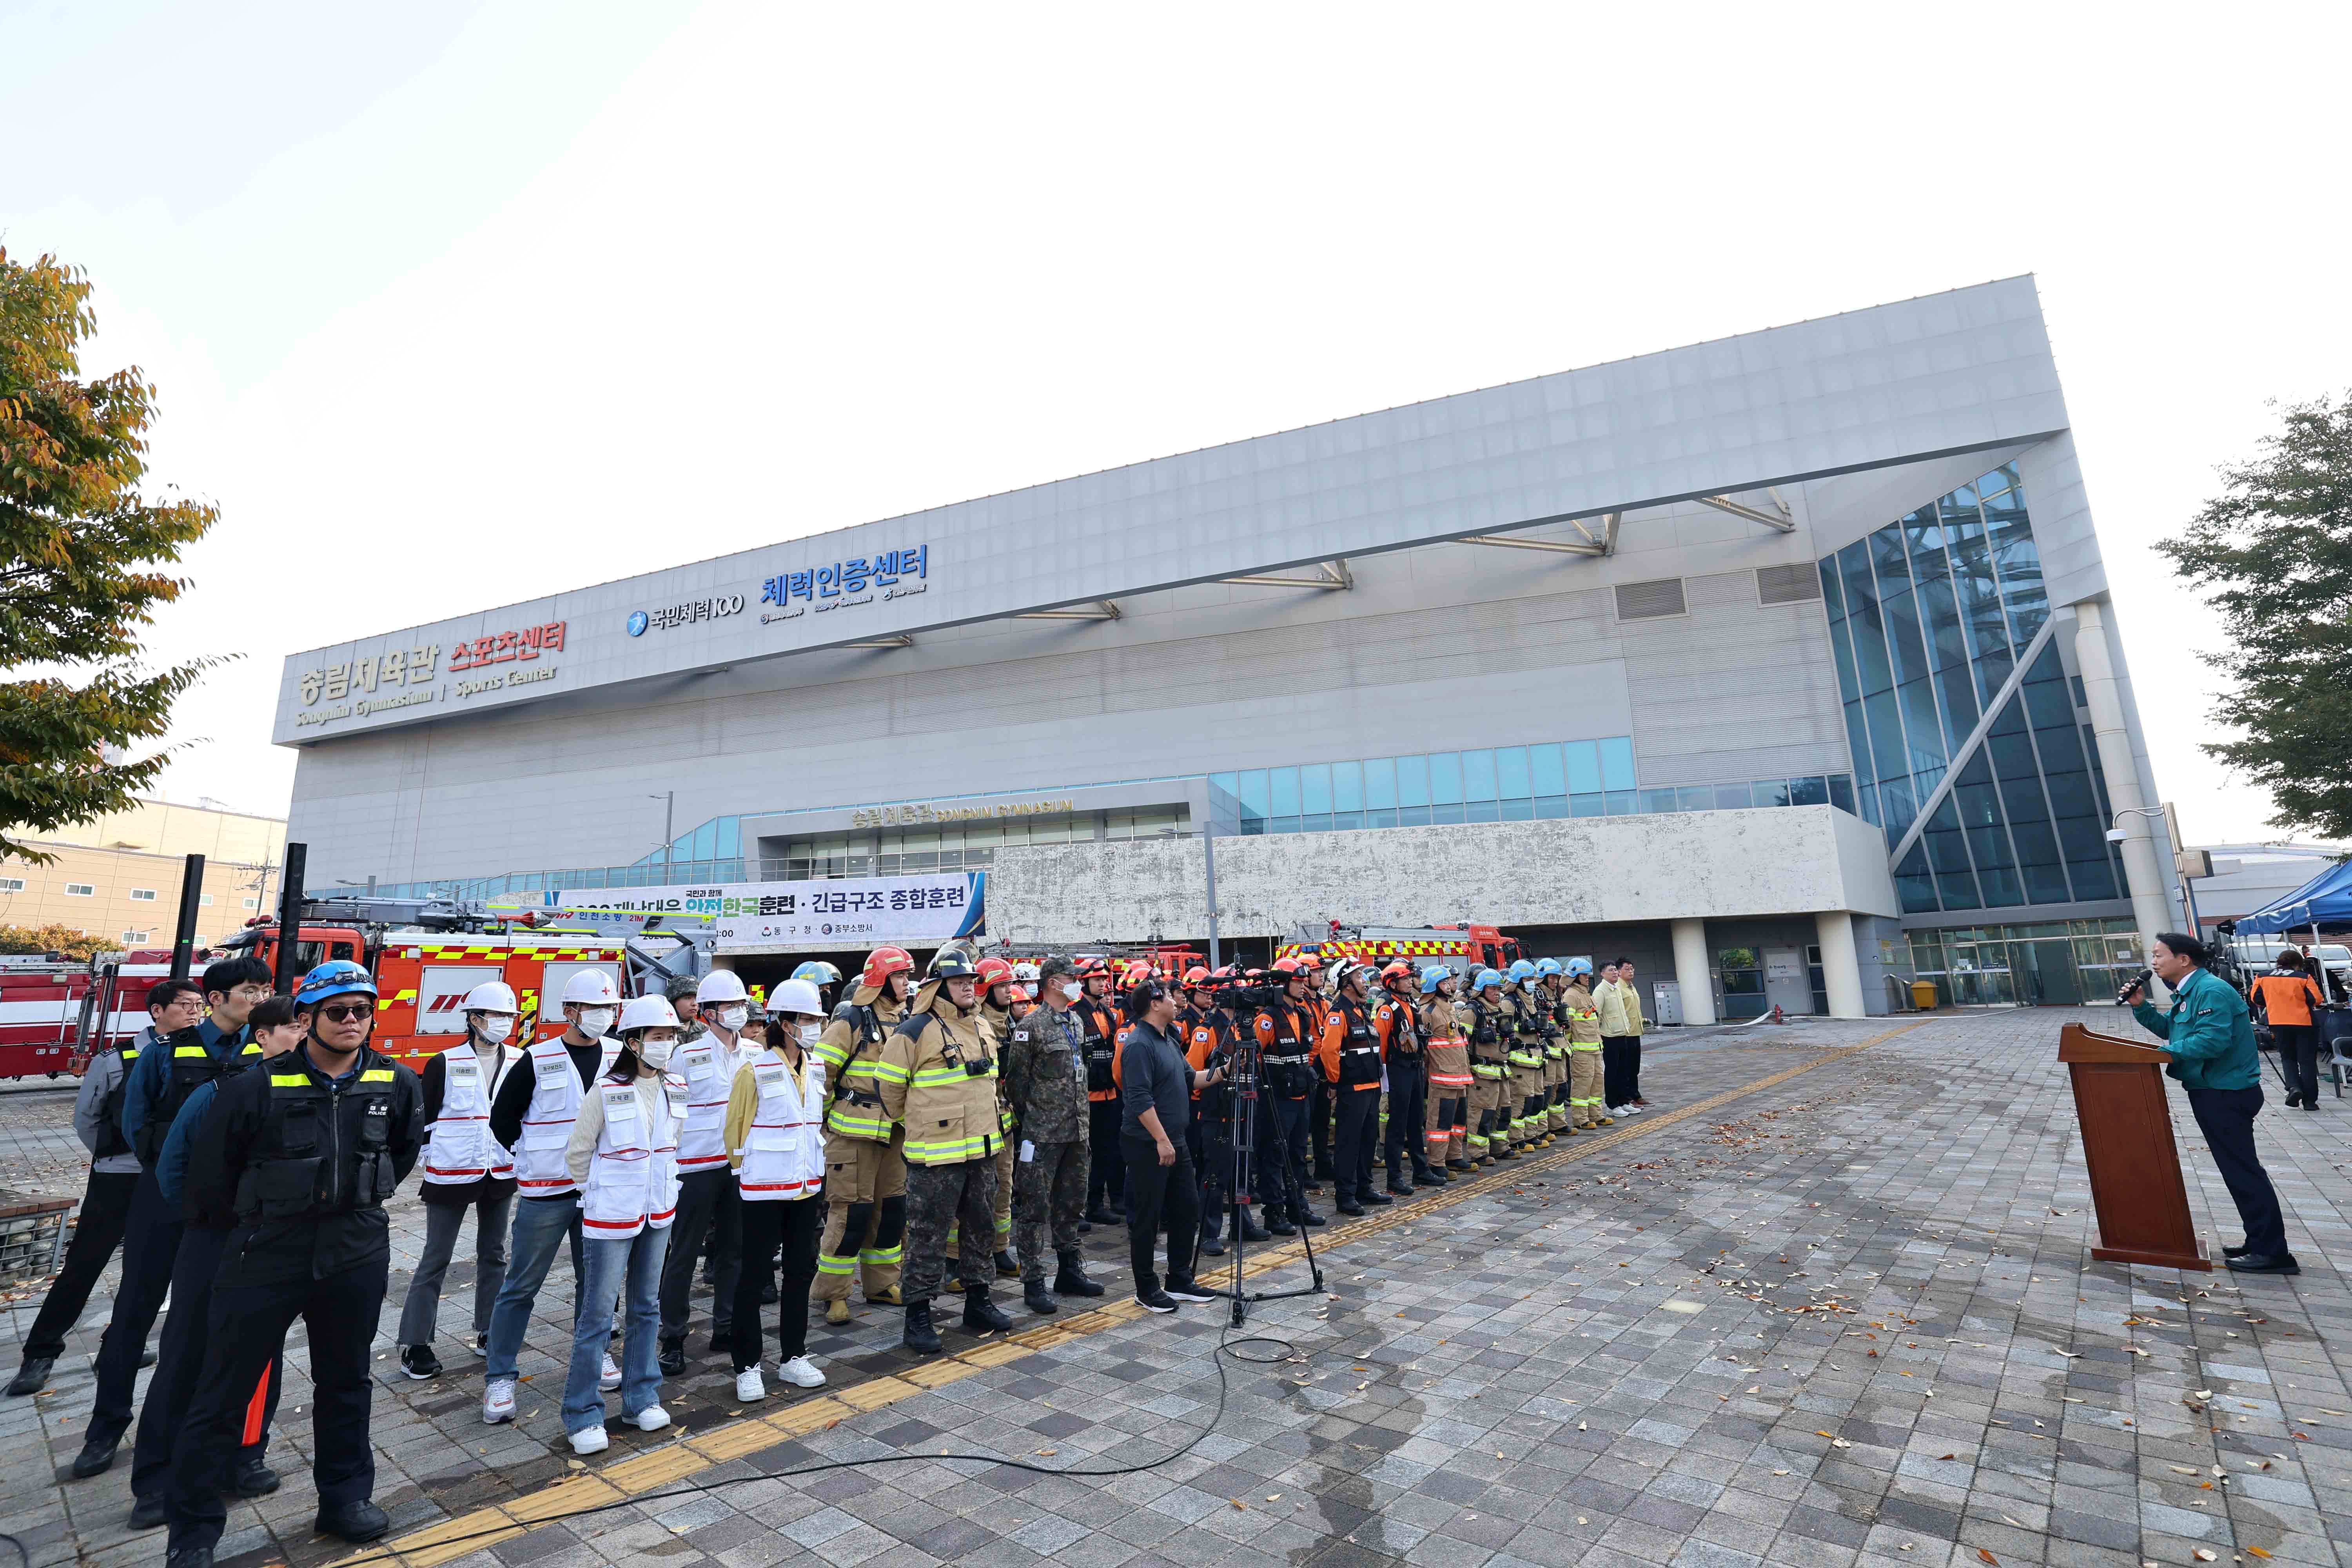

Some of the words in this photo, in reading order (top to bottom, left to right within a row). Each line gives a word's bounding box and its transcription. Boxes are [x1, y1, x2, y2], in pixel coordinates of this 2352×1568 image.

[760, 543, 927, 606] 체력인증센터
[650, 593, 744, 630] 국민체력100
[815, 602, 835, 612] KSPO
[299, 644, 440, 706] 송림체육관
[448, 621, 566, 671] 스포츠센터
[356, 690, 433, 717] Gymnasium
[455, 675, 502, 699] Sports
[505, 666, 557, 686] Center
[852, 803, 934, 829] 송림체육관
[935, 805, 993, 822] SONGNIM
[996, 799, 1073, 817] GYMNASIUM
[708, 889, 722, 897] 함께
[811, 891, 885, 913] 긴급구조
[890, 886, 964, 910] 종합훈련
[834, 924, 873, 933] 중부소방서
[425, 990, 472, 1013] 11
